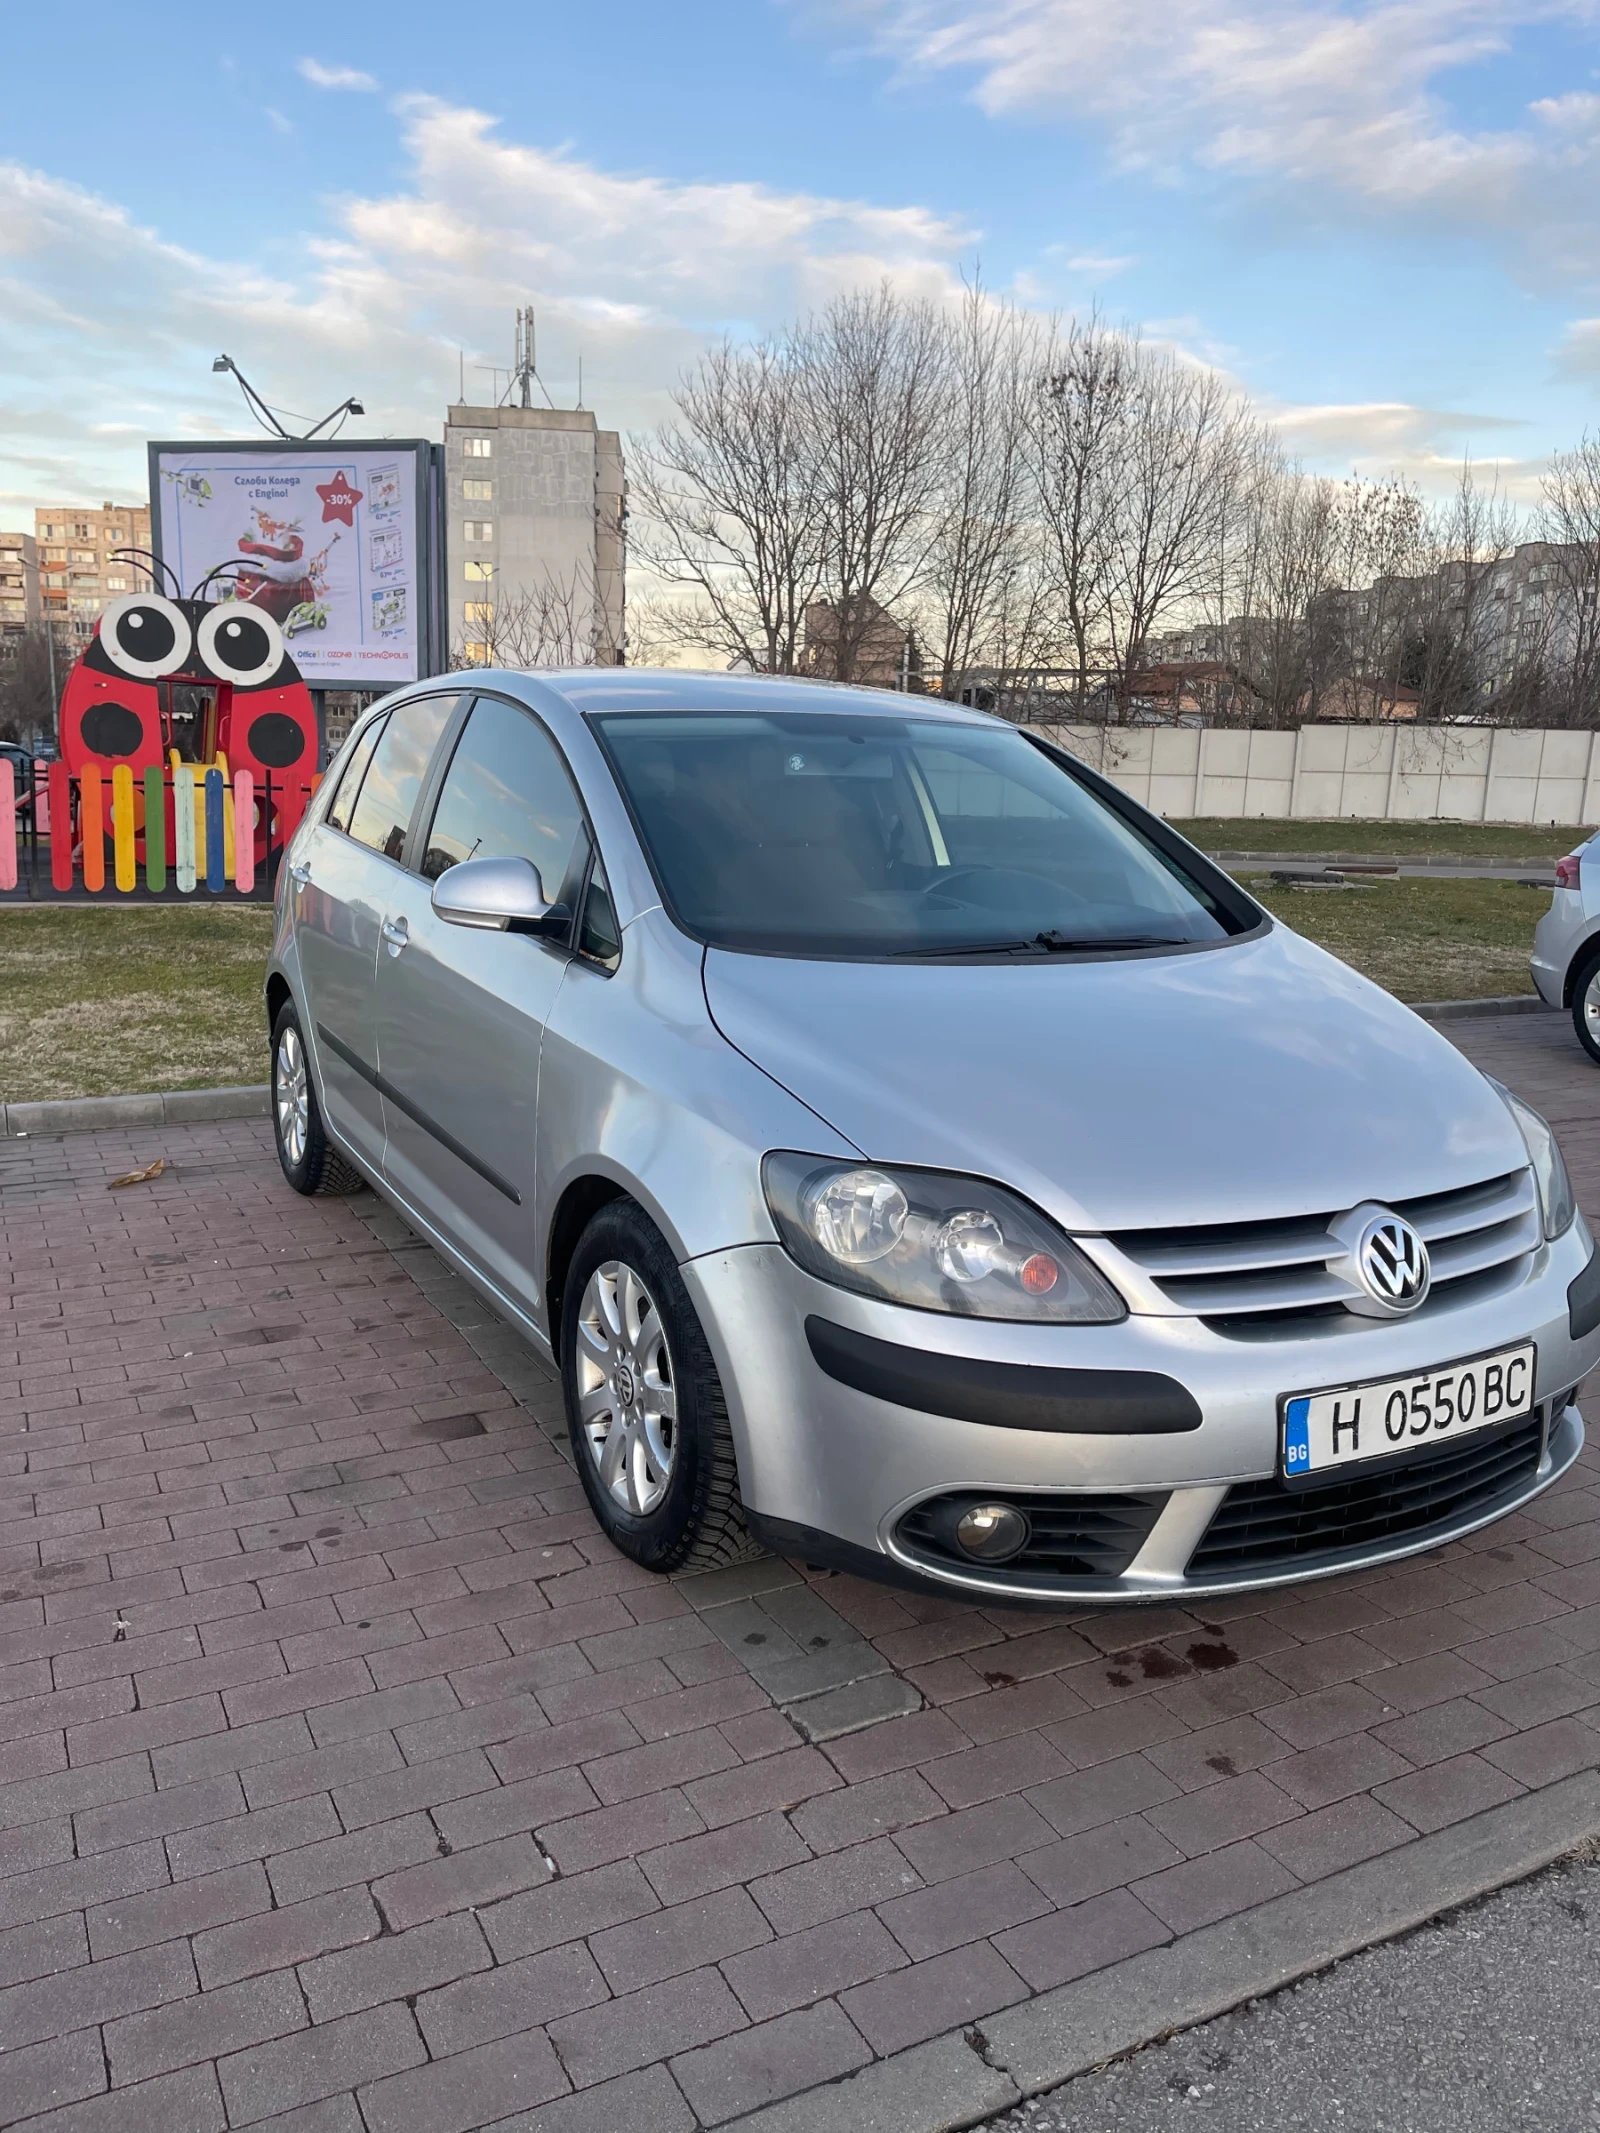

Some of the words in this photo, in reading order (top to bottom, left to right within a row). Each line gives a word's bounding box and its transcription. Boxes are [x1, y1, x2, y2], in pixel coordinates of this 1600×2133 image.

[234, 476, 267, 486] Сглоби
[268, 476, 301, 487] Коледа
[255, 489, 289, 499] Engino!
[326, 494, 353, 505] -30%
[358, 650, 409, 660] TECHNOPOLIS
[1332, 1398, 1362, 1455] H
[1287, 1444, 1308, 1463] BG
